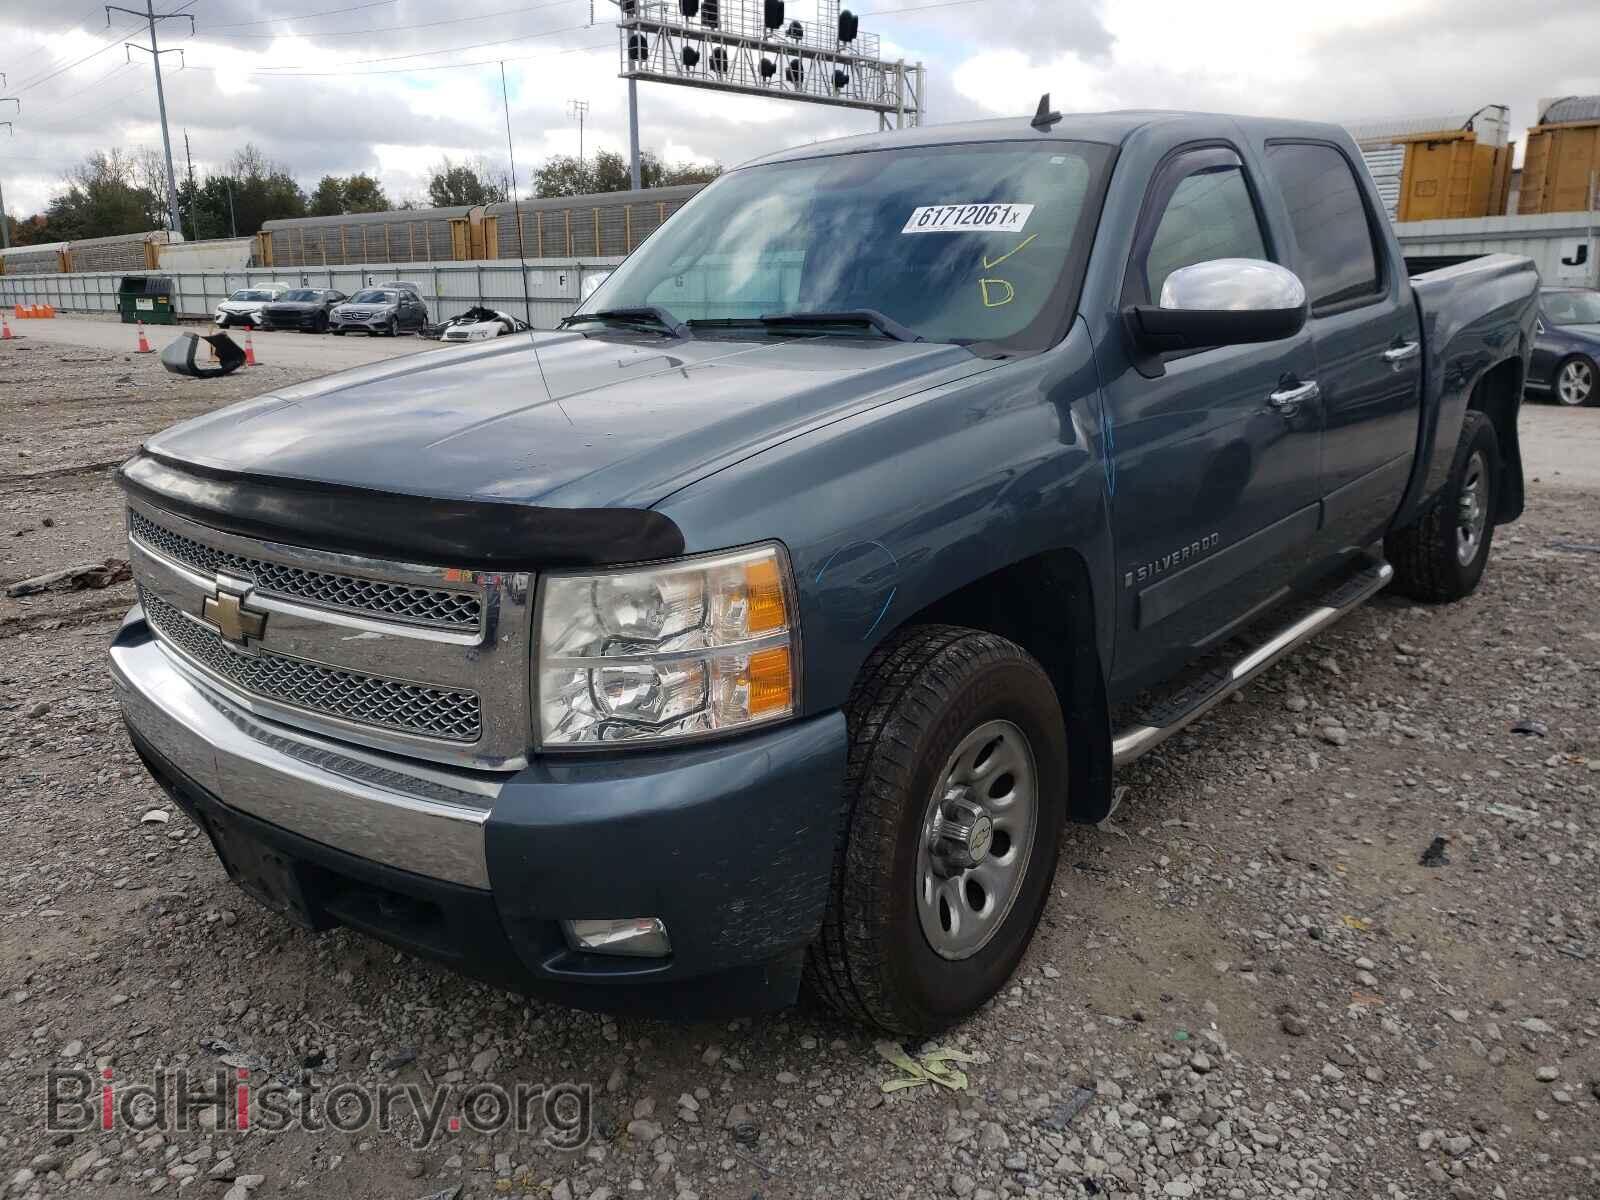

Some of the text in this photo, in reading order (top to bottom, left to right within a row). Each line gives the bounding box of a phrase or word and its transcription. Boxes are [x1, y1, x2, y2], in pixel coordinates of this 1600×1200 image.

[1561, 244, 1588, 266] J
[559, 275, 567, 286] F
[978, 277, 1015, 307] D
[1136, 531, 1220, 582] SILVERADO
